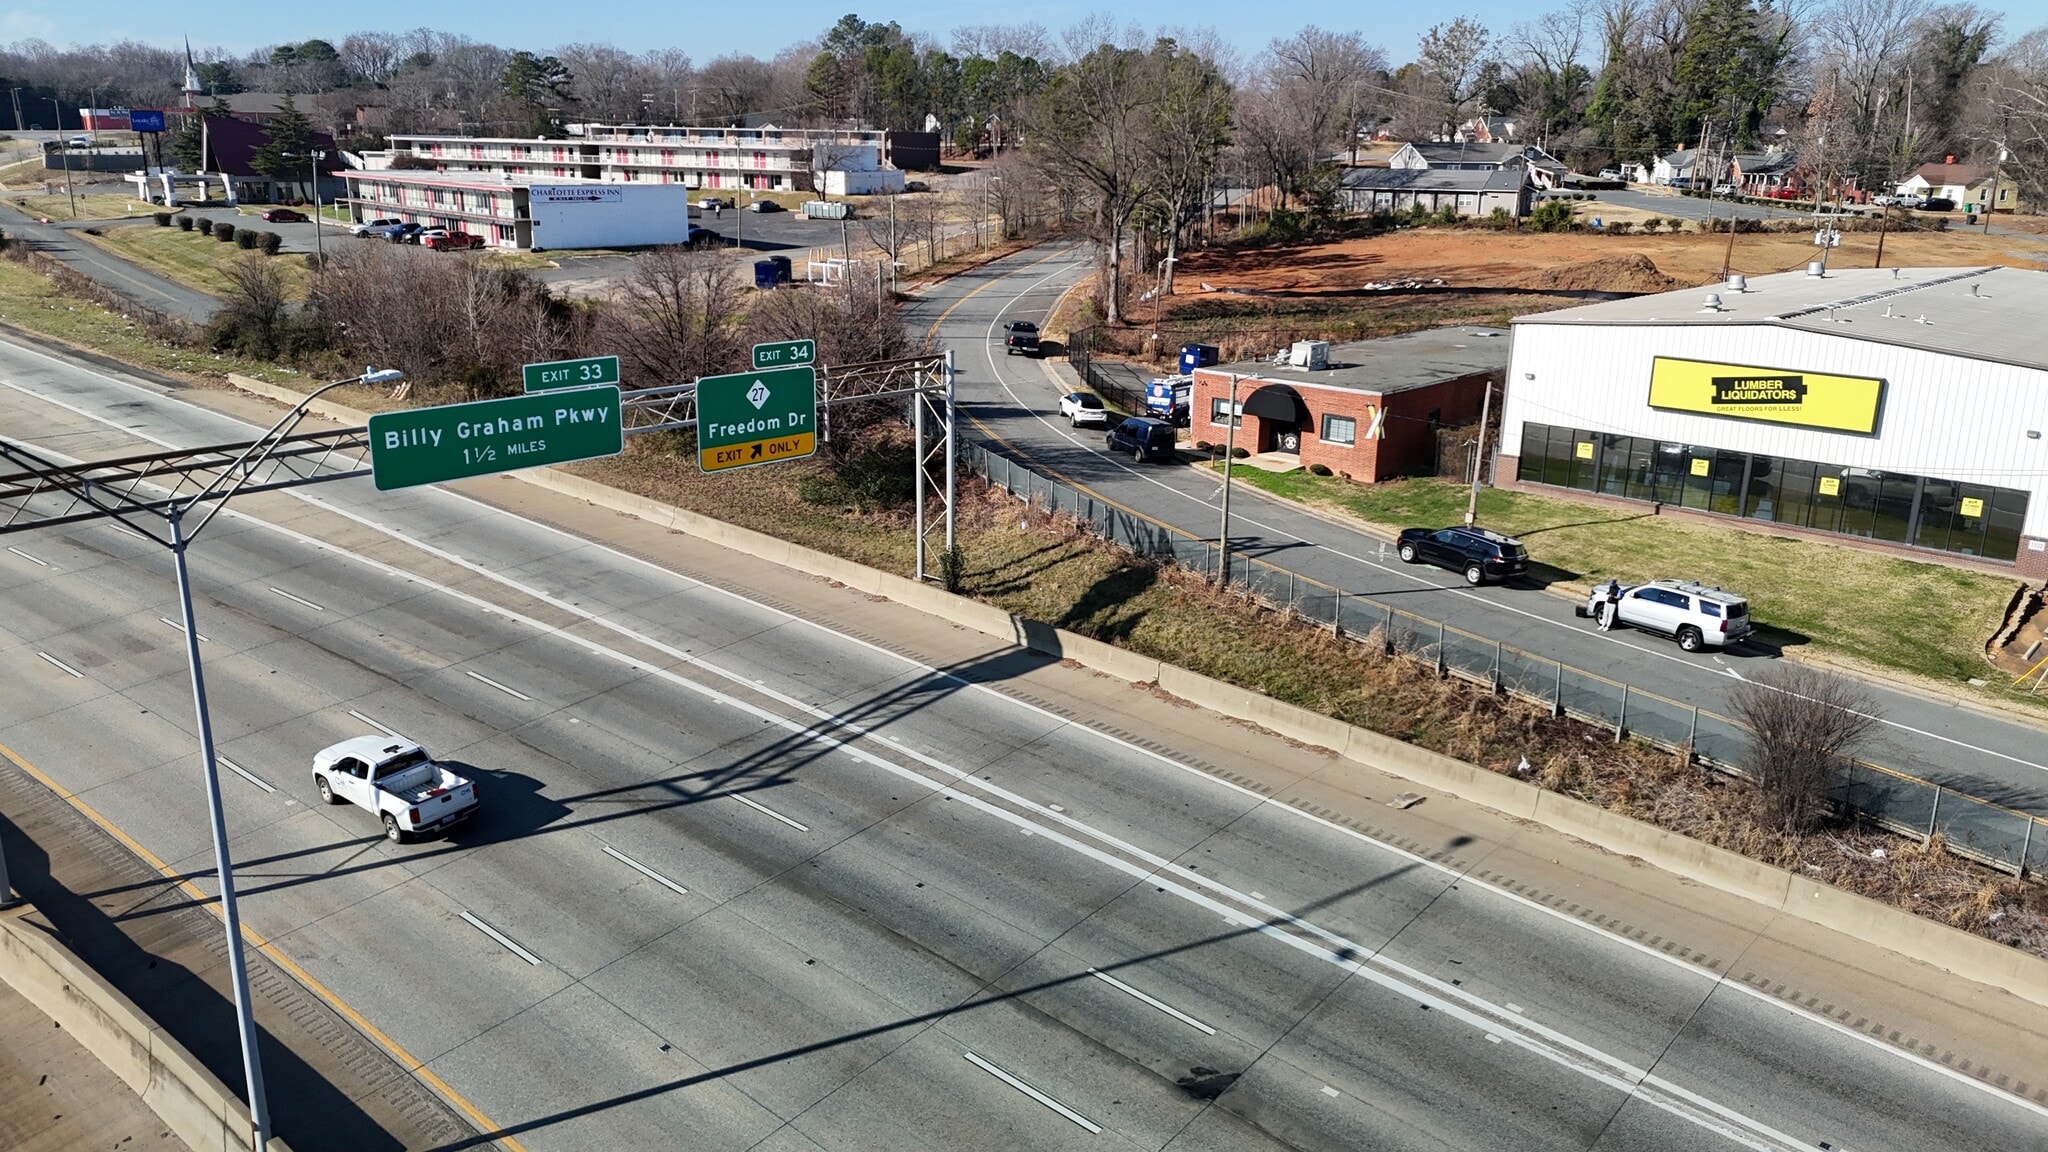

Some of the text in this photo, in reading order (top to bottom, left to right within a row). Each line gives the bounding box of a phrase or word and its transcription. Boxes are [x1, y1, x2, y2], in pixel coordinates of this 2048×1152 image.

[531, 188, 620, 196] CHARLOTTE EXPRESS INN
[759, 345, 809, 362] EXIT 34
[541, 363, 602, 383] EXIT 33
[1734, 380, 1783, 390] LUMBER
[751, 387, 765, 402] 27
[384, 406, 609, 450] Billy Graham Pkwy
[708, 412, 806, 439] Freedom Dr
[507, 440, 546, 456] MILES
[717, 439, 800, 464] EXIT ONLY
